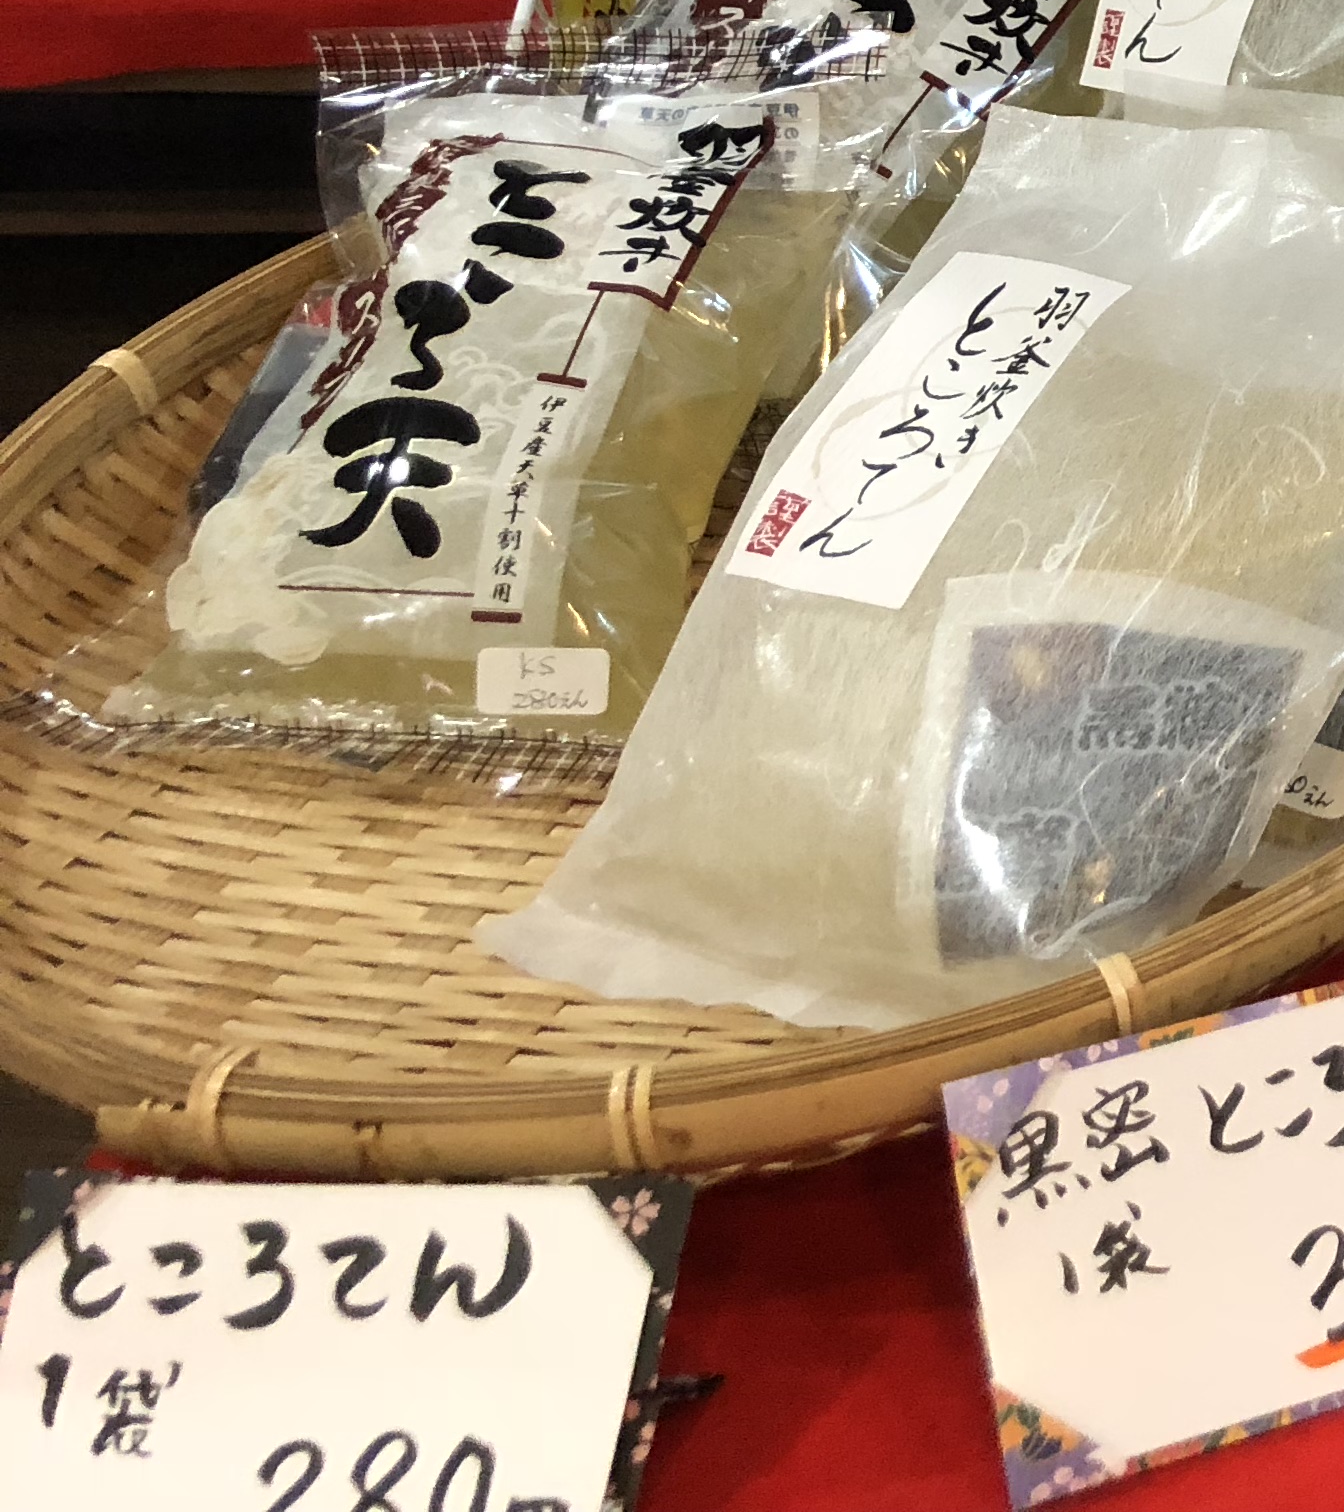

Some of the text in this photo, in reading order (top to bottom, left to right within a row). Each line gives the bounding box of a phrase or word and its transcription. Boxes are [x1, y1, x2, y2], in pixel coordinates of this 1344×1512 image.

[799, 281, 1008, 559] ところてん
[934, 284, 1092, 470] 羽釜炊き
[59, 1214, 534, 1331] ところてん
